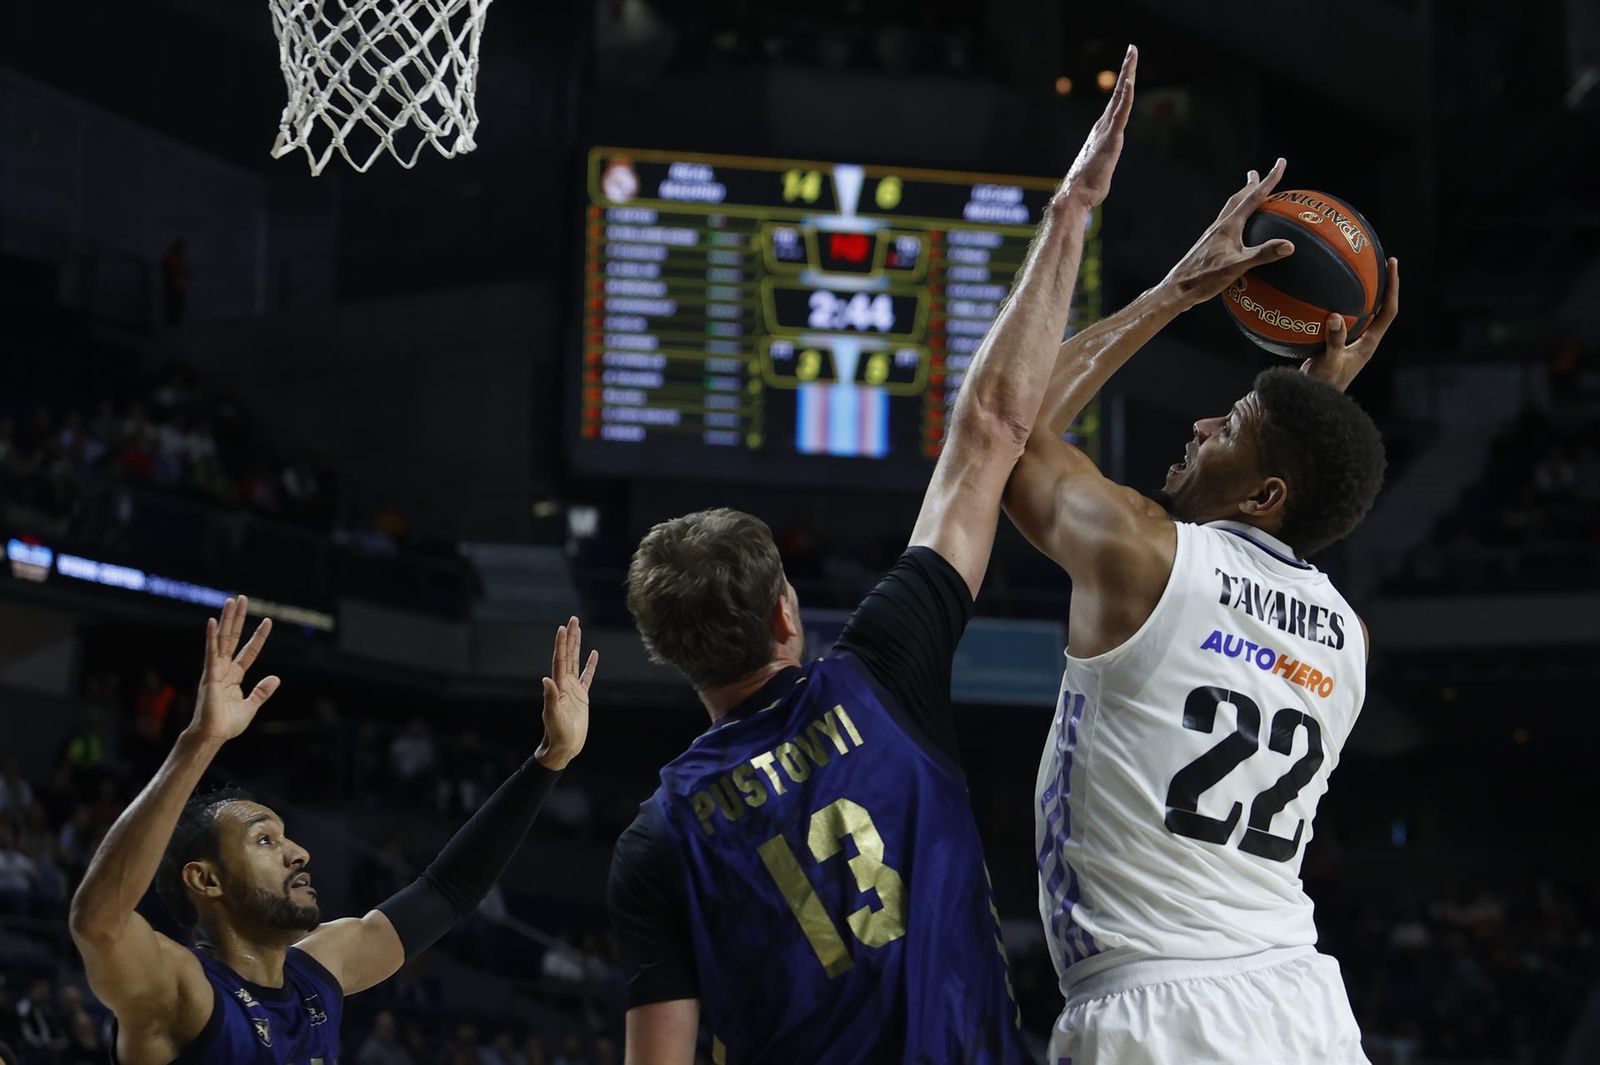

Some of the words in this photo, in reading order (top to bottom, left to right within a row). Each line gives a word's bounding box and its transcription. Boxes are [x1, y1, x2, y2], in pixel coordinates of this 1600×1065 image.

[782, 169, 822, 204] 14
[1275, 192, 1370, 253] SPALDING
[808, 289, 896, 332] 2:44
[1215, 567, 1345, 650] TAVARES
[1200, 630, 1335, 699] AUTOHERO
[691, 704, 864, 836] PUSTOVYI
[1164, 685, 1325, 863] 22
[756, 797, 907, 980] 13
